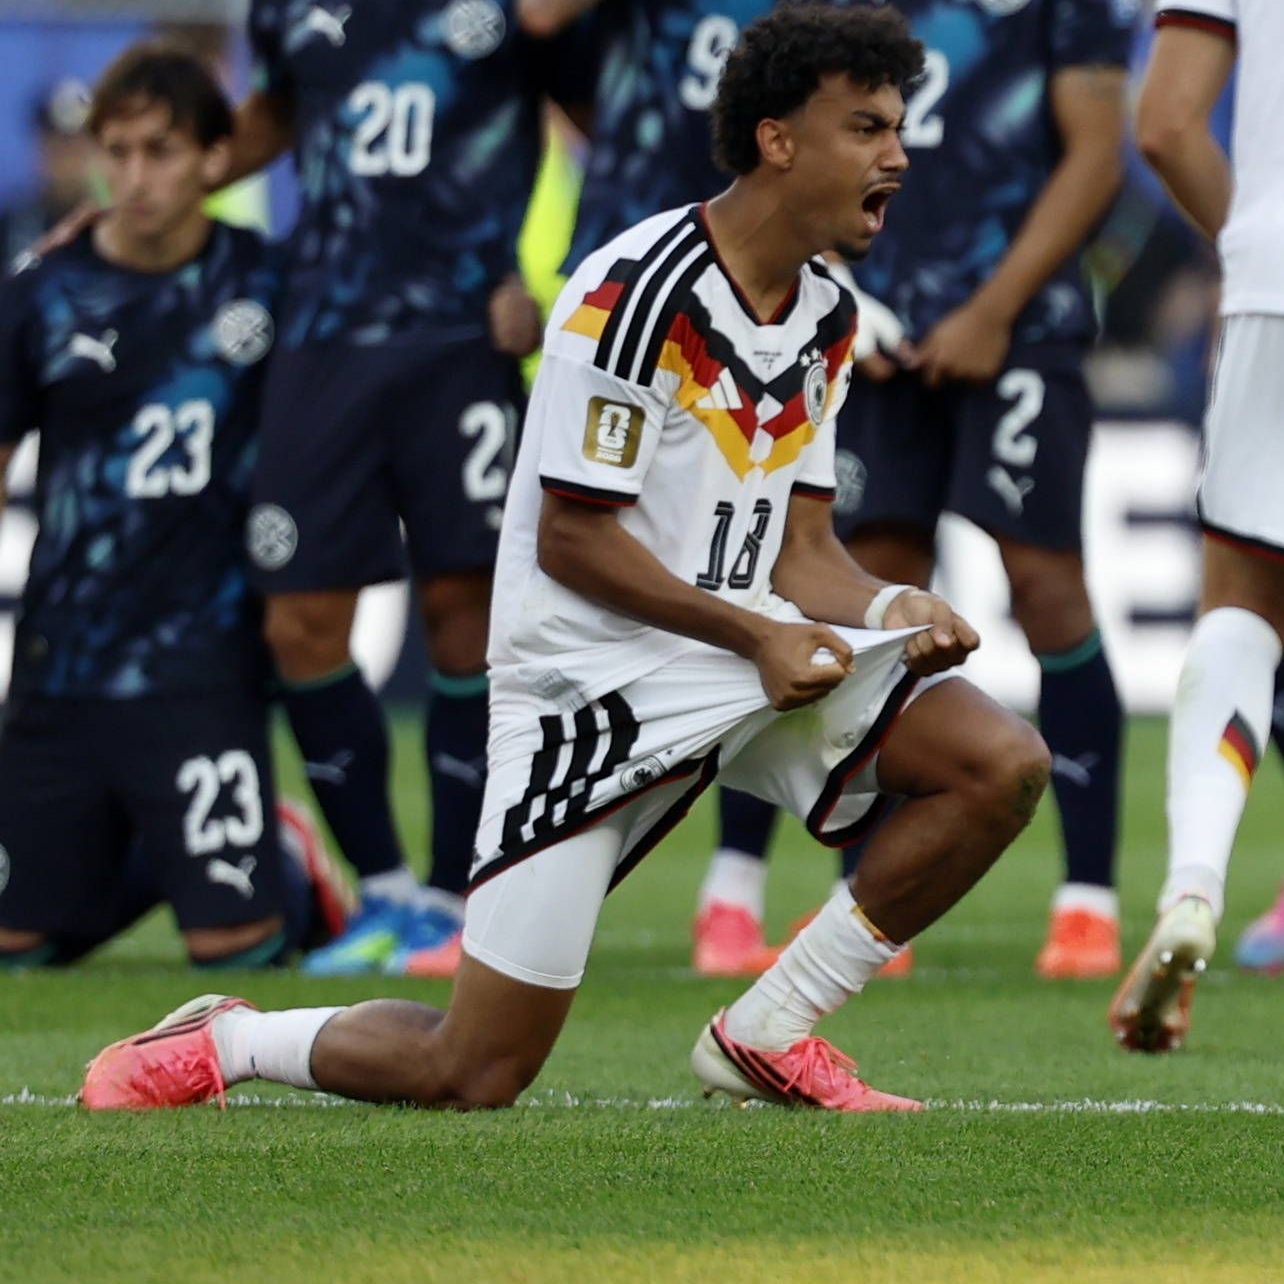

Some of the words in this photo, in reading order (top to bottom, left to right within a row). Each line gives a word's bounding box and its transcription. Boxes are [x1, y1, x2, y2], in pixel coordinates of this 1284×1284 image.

[348, 82, 436, 176] 20
[126, 399, 214, 498] 23
[993, 367, 1045, 468] 2
[696, 498, 772, 591] 18
[177, 748, 263, 855] 23
